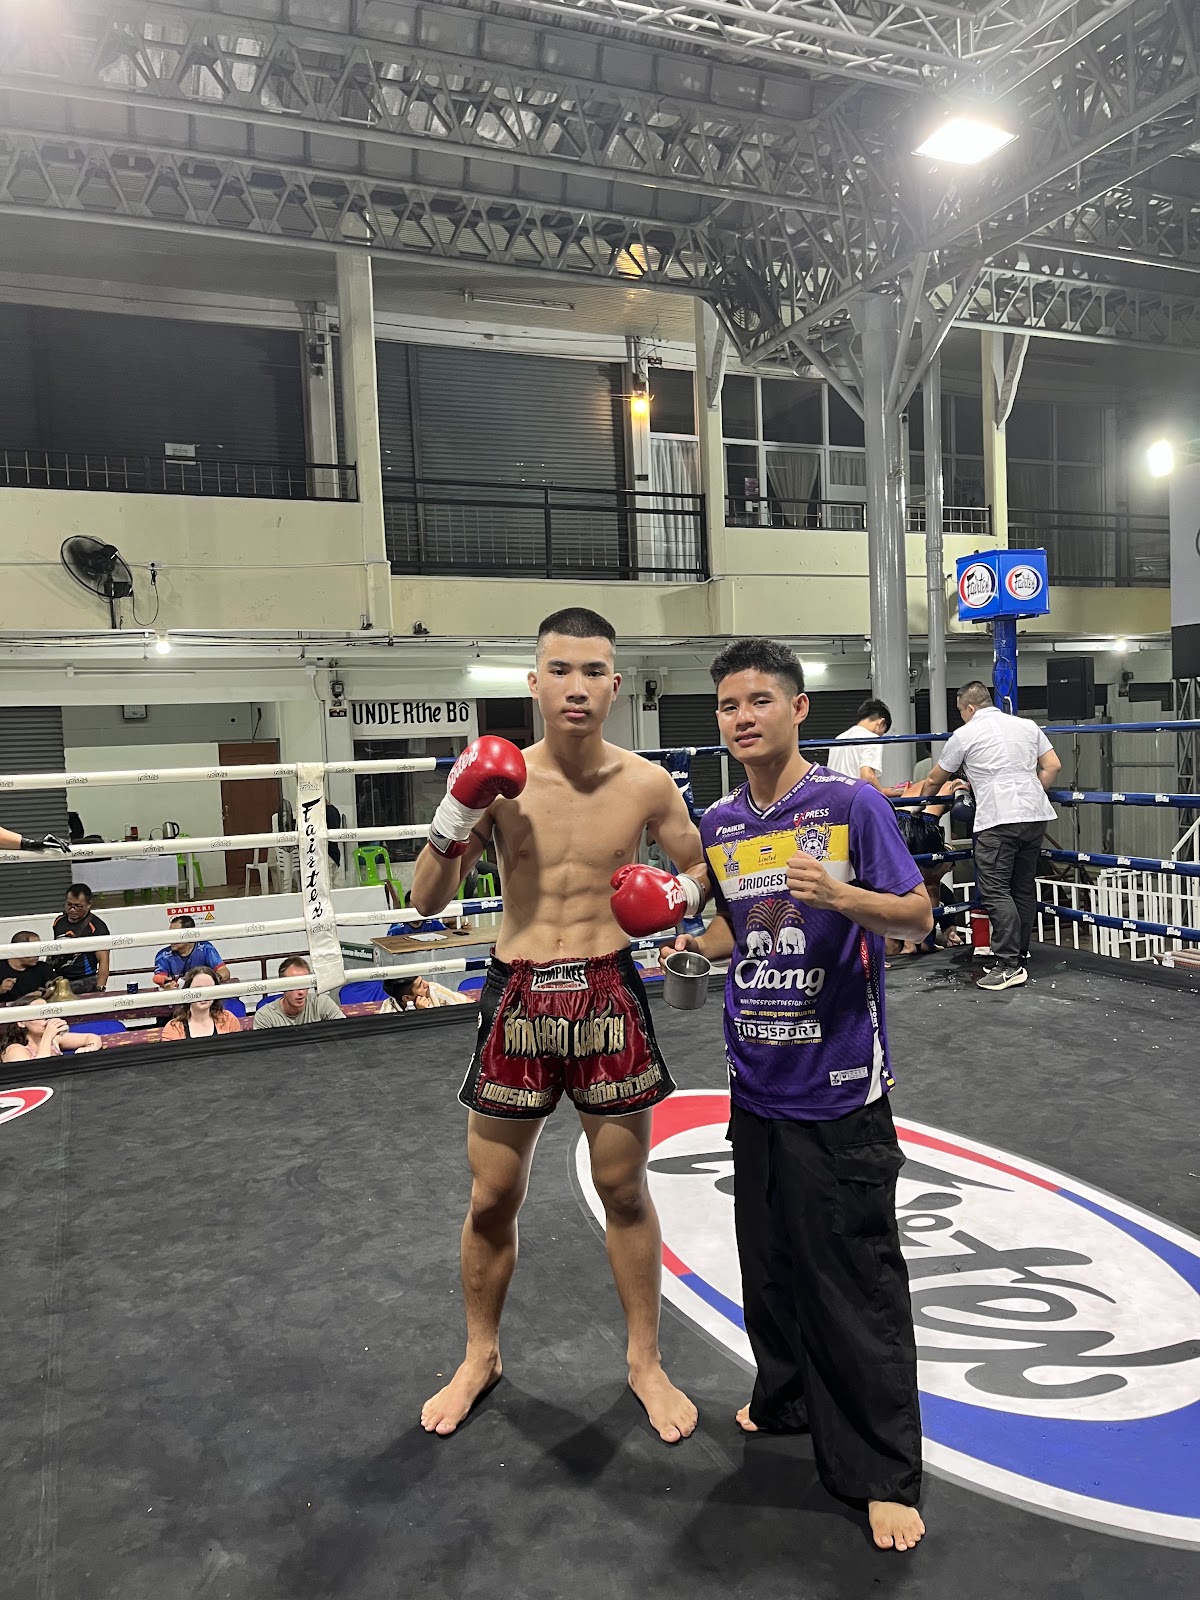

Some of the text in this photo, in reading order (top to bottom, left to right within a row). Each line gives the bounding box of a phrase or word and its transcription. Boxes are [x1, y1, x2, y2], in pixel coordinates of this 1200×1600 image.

[792, 779, 806, 793] SPORT
[794, 808, 830, 821] EXPRESS
[722, 823, 746, 834] DAIKIN
[301, 796, 323, 920] Fairtex
[738, 873, 788, 891] BRIDGEST
[735, 959, 826, 997] Chang
